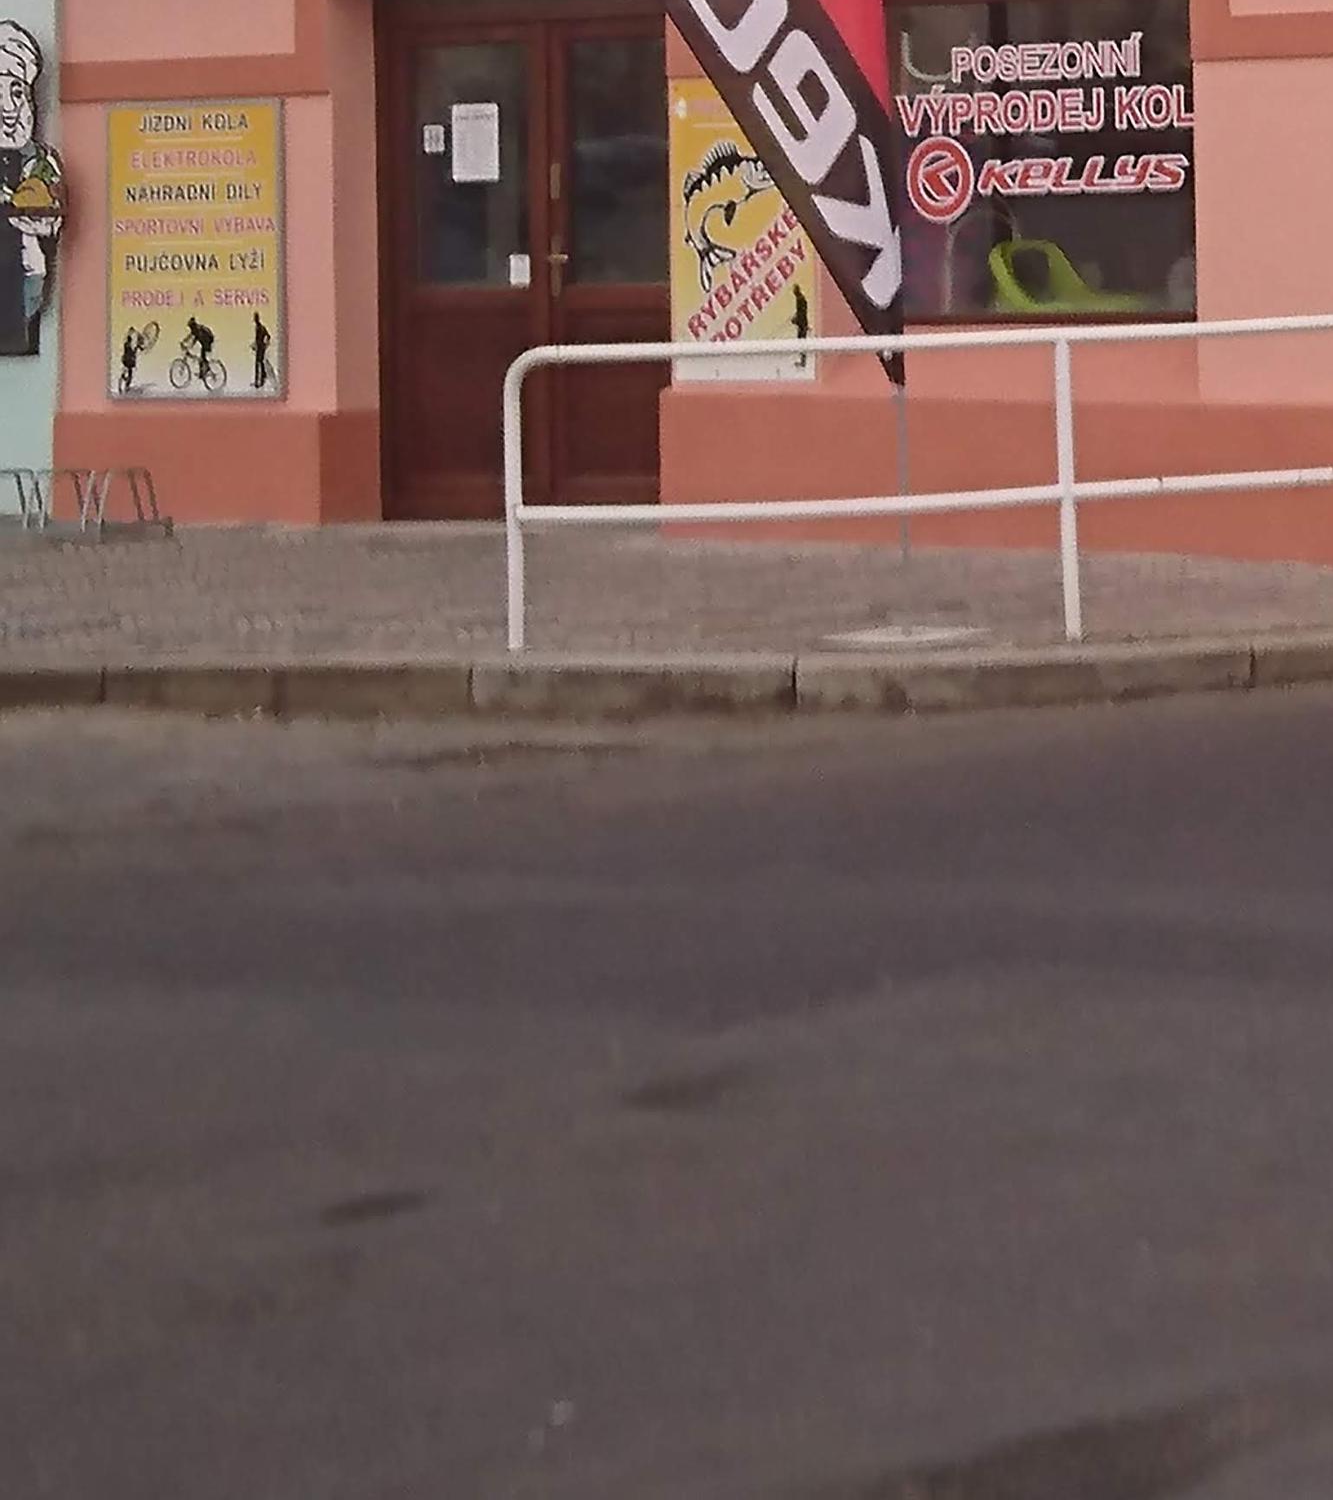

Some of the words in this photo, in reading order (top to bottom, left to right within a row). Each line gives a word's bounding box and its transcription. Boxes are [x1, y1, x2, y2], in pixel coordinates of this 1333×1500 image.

[951, 31, 1143, 84] POSEZONNÍ
[896, 84, 1105, 137] VÝPRODEJ
[1115, 84, 1195, 131] KOL
[202, 111, 249, 131] KOLA
[130, 149, 258, 169] ELEKTROKOLA
[193, 289, 205, 306] A
[213, 288, 270, 306] SERVIS
